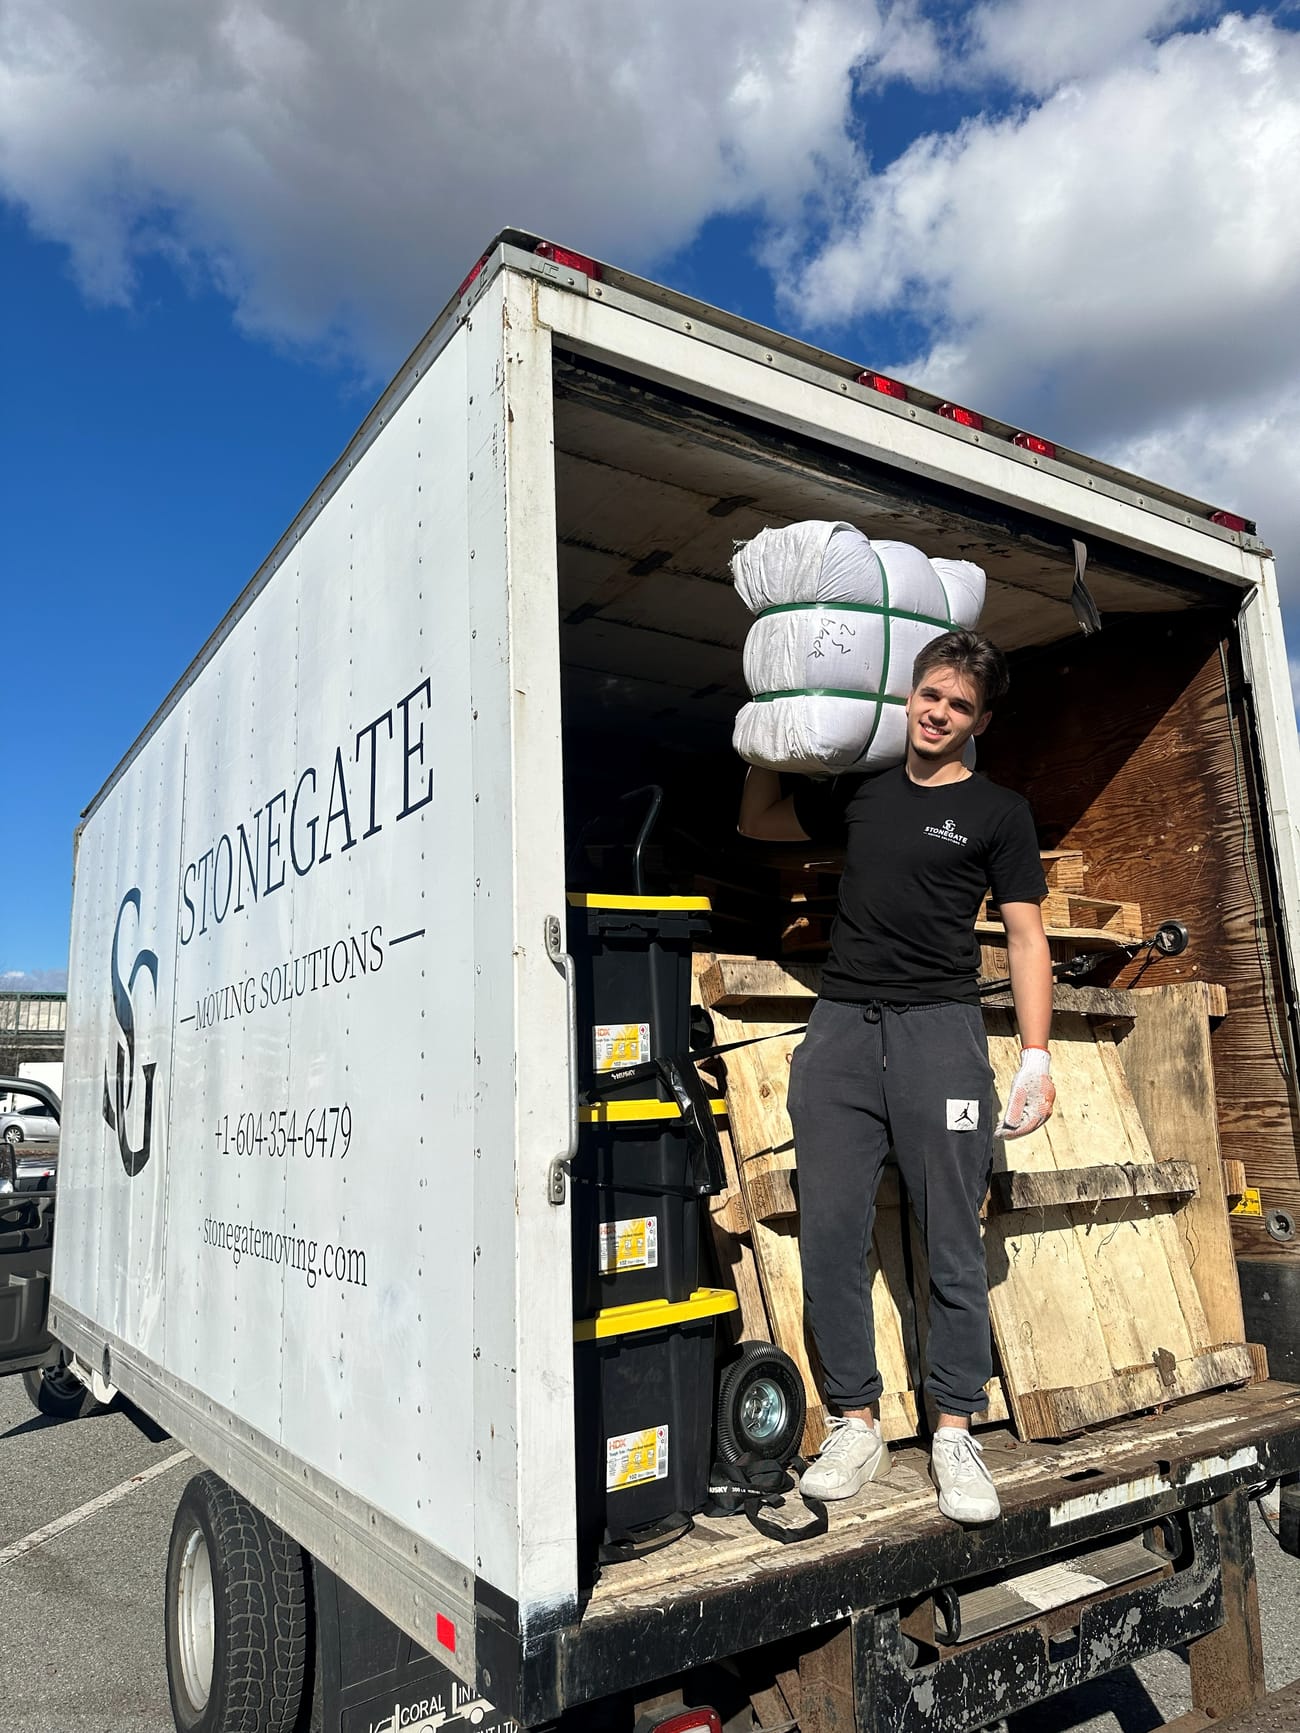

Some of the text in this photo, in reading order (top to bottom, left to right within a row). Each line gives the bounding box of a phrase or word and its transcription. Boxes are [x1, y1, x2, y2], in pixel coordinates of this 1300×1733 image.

[180, 677, 434, 946] STONEGATE
[924, 826, 968, 844] STONEGATE
[195, 925, 384, 1031] MOVING SOLUTIONS
[215, 1105, 352, 1159] +1-604-354-6479
[203, 1212, 368, 1288] stonegatemoving.com
[400, 1694, 446, 1725] CORAL
